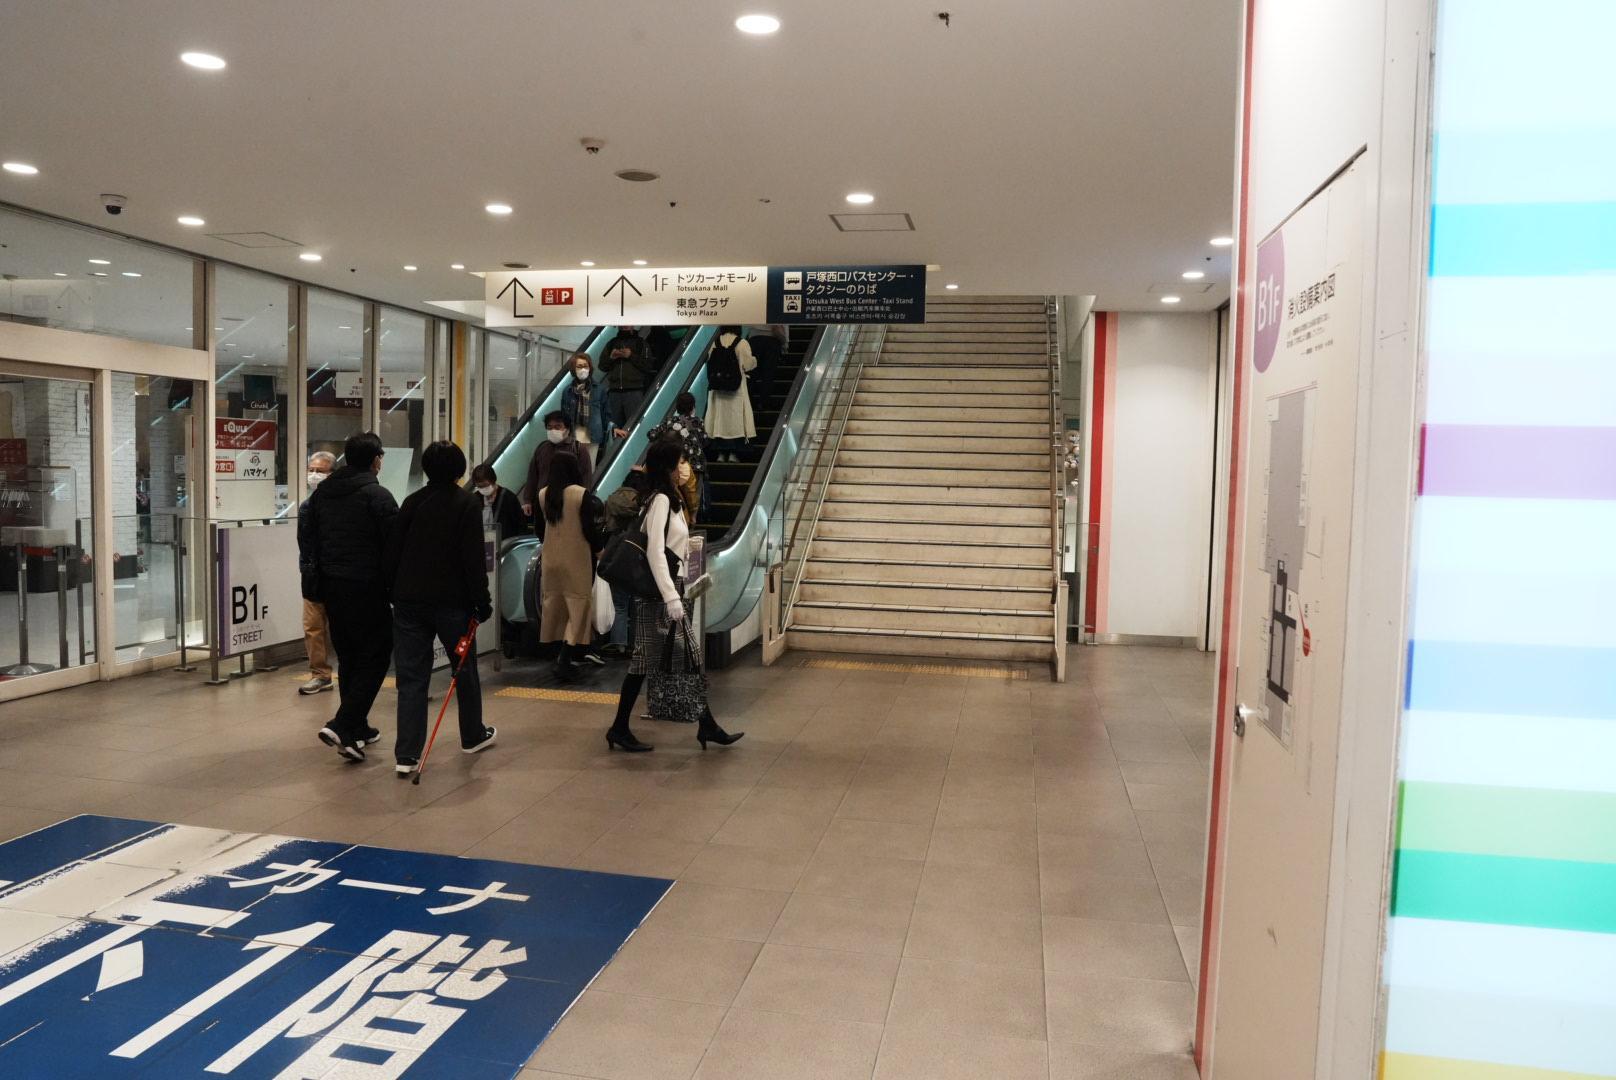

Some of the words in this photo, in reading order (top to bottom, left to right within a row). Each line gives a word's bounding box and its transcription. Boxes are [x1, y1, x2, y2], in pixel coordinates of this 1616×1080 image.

[651, 273, 669, 292] 1F
[677, 272, 757, 284] トツカーナモール
[806, 284, 877, 295] タクシーのりば
[561, 290, 570, 303] P
[1257, 273, 1281, 332] B1F
[676, 297, 730, 309] 東急プラザ
[676, 310, 697, 318] Tokyu
[243, 467, 268, 477] ハマケイ
[232, 583, 269, 625] B1F
[232, 629, 265, 646] STREET
